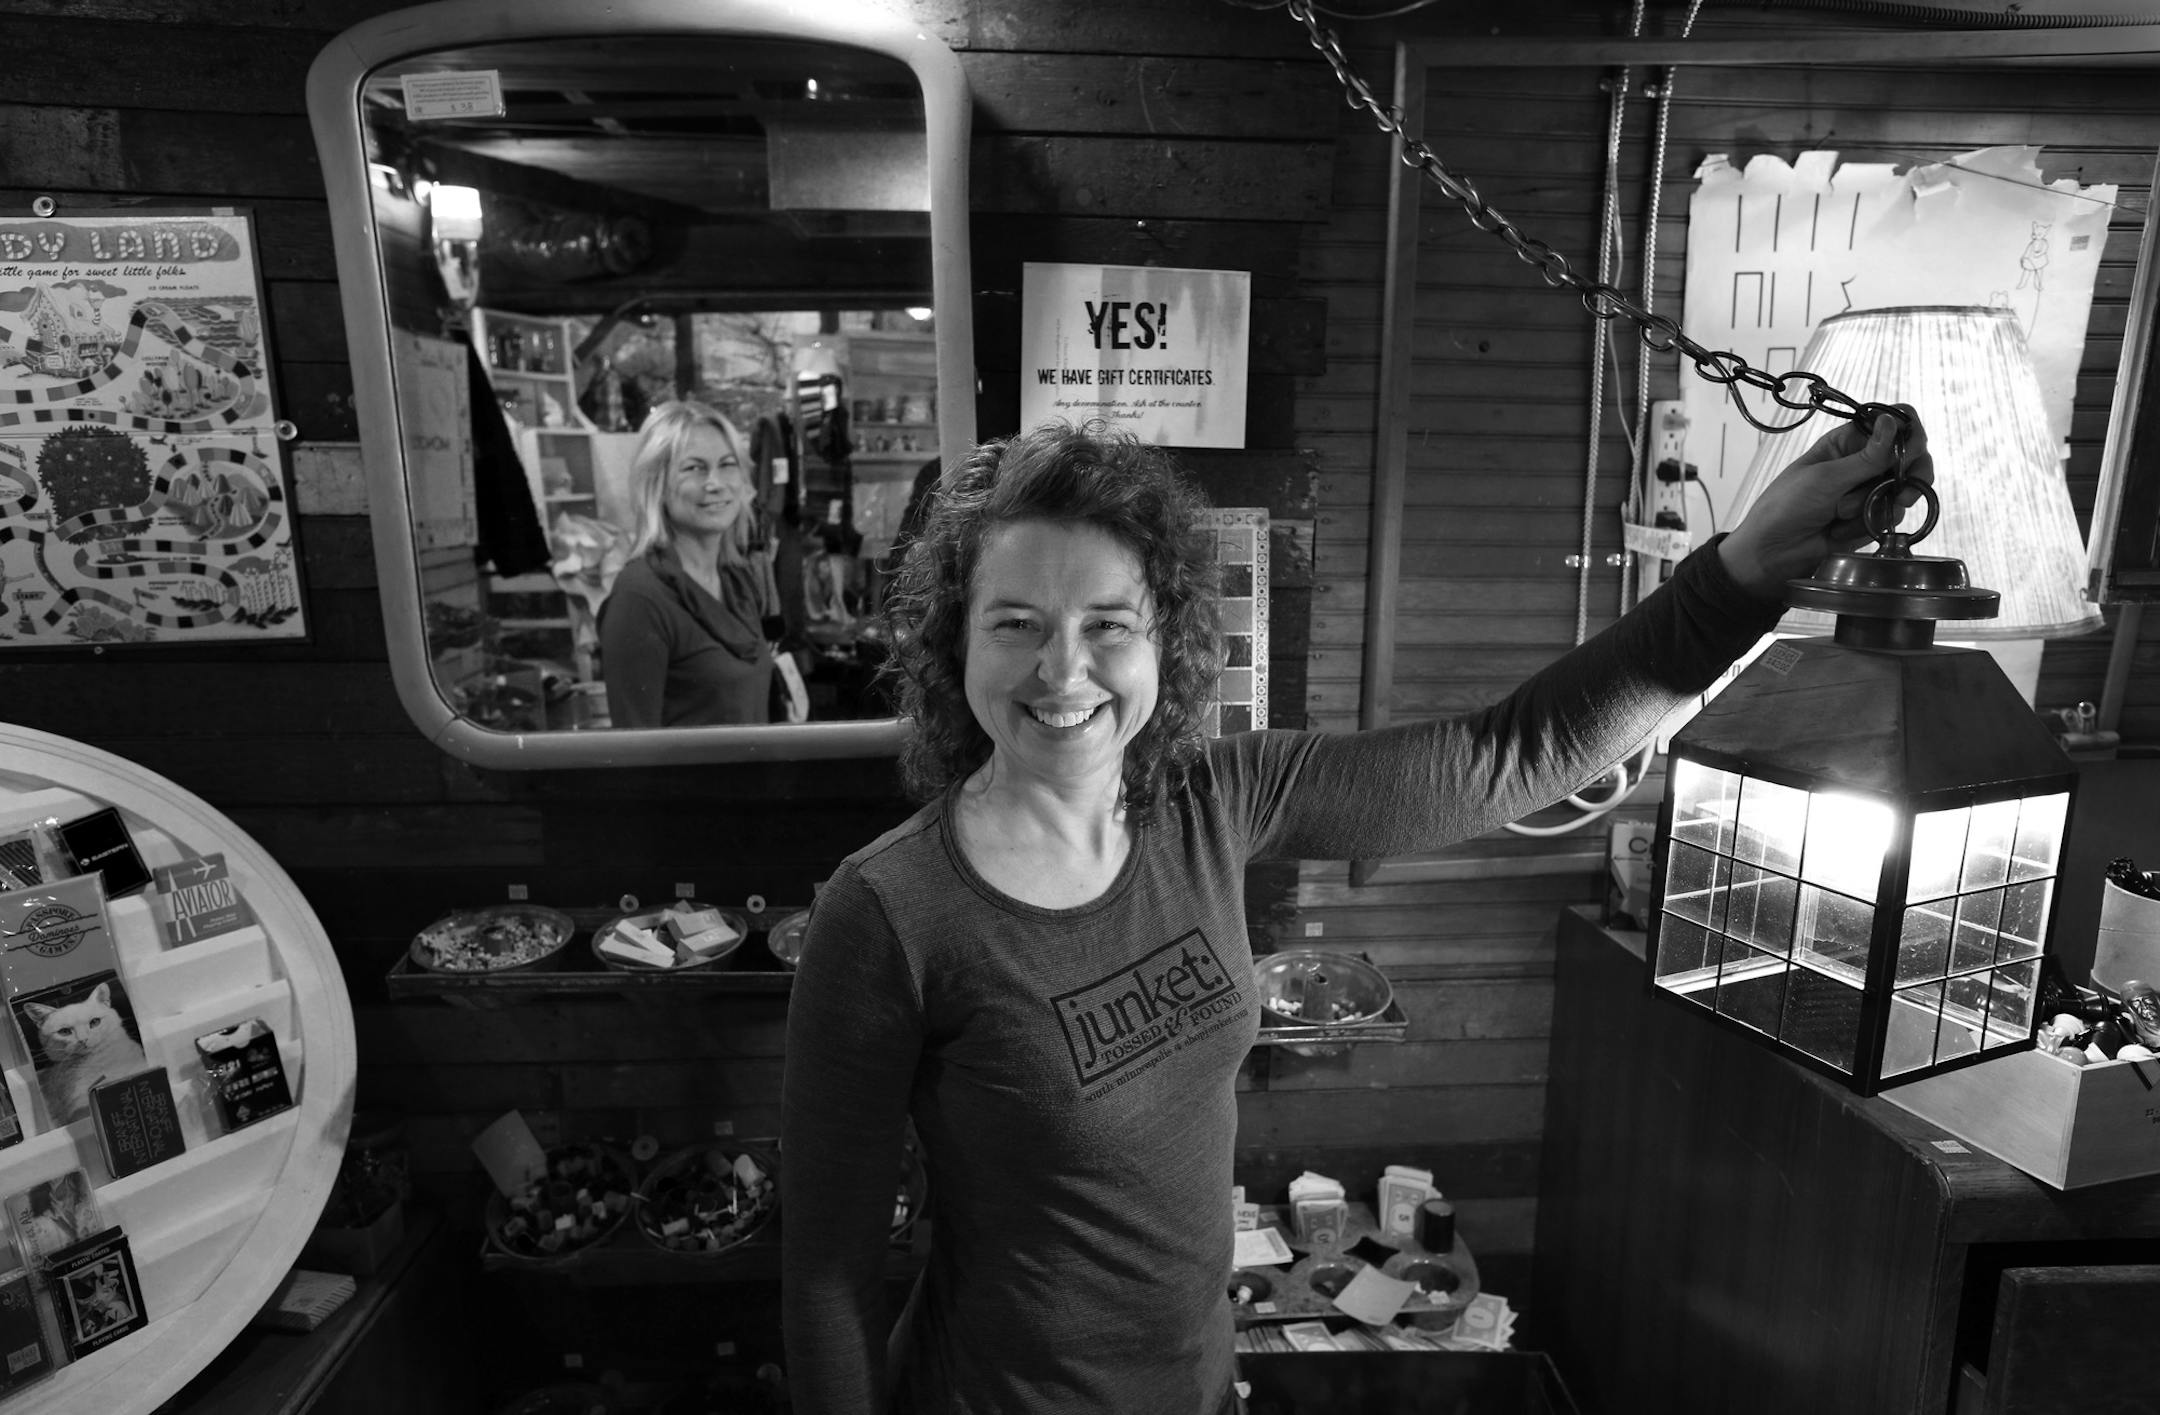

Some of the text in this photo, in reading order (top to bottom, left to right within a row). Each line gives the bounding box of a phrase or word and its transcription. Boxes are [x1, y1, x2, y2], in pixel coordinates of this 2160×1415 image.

[90, 231, 219, 259] LAND
[27, 268, 58, 280] game
[62, 266, 80, 280] for
[86, 268, 118, 277] sweet
[123, 265, 152, 276] little
[1084, 300, 1168, 350] YES!
[1037, 368, 1057, 385] WE
[1061, 369, 1093, 385] HAVE
[1098, 369, 1125, 386] GIFT
[1158, 400, 1170, 408] the
[172, 880, 233, 920] AVIATOR
[26, 907, 76, 928] PASSPORT
[28, 924, 80, 942] Dominoes
[1100, 991, 1242, 1064] TOSSED & FOUND
